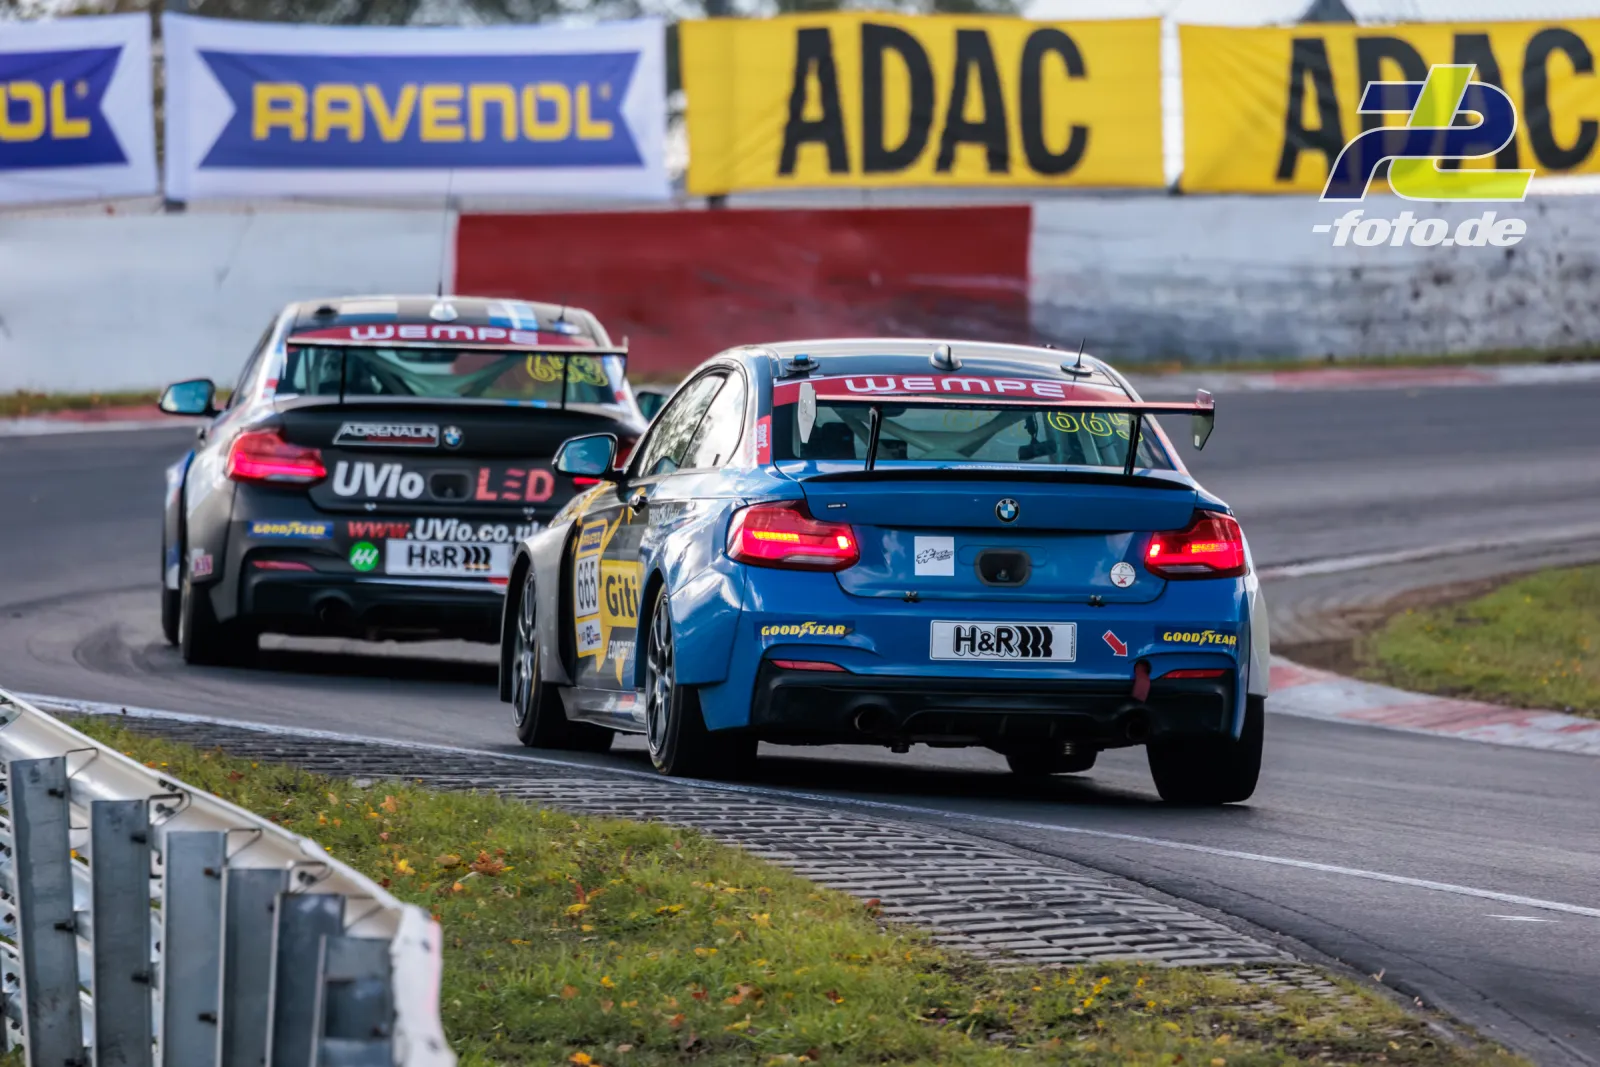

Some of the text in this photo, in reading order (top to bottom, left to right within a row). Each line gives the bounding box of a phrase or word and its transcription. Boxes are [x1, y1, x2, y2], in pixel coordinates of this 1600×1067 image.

[251, 83, 613, 142] RAVENOL
[778, 22, 1089, 177] ADAC
[1276, 27, 1600, 183] ADAC
[350, 324, 538, 345] WEMPE
[844, 377, 1066, 399] WEMPE
[332, 461, 555, 502] UVio LED
[253, 521, 325, 536] GOODYEAR
[407, 545, 459, 568] H&R
[578, 561, 597, 610] 665
[761, 621, 846, 638] GOODYEAR
[954, 625, 1019, 658] H&R
[1163, 630, 1237, 646] GOODYEAR
